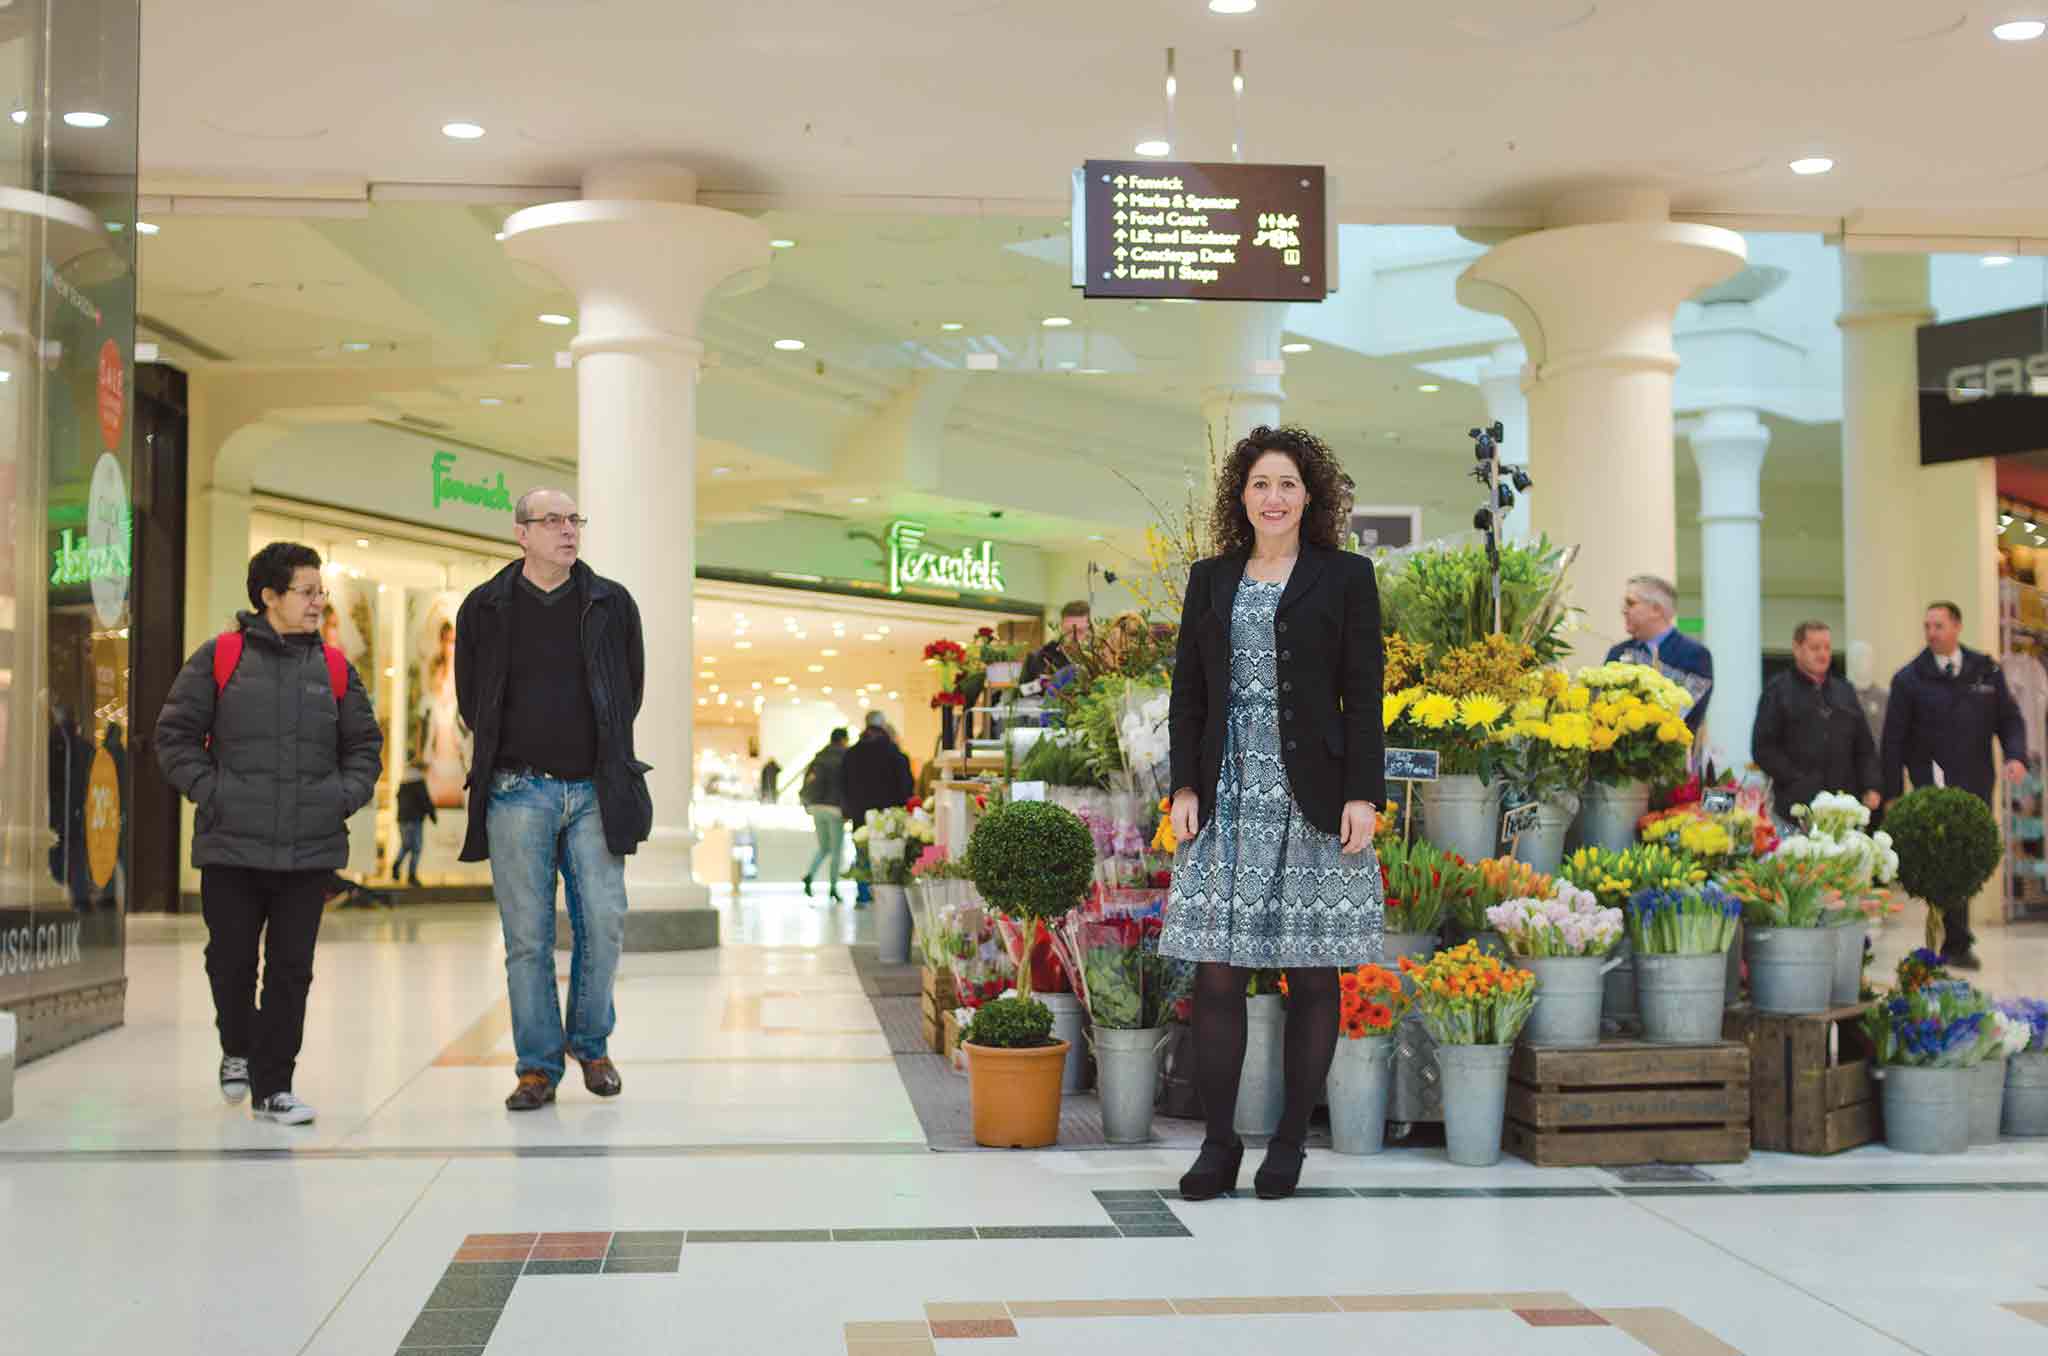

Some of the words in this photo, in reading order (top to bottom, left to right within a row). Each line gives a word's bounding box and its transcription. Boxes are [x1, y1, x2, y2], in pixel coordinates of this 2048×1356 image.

[1129, 175, 1184, 190] Fenwick
[1129, 193, 1171, 208] Marks
[1171, 194, 1185, 208] &
[1185, 194, 1240, 212] Spencer
[1130, 211, 1165, 226] Food
[1165, 211, 1209, 227] Court
[1130, 228, 1153, 243] Lift
[1153, 229, 1180, 244] and
[1180, 230, 1241, 246] Escalator
[1130, 246, 1199, 266] Concierge
[1200, 248, 1236, 263] Desk
[1130, 265, 1165, 280] Level
[1168, 265, 1175, 279] 1
[1178, 266, 1219, 284] Shops
[432, 450, 513, 513] Fenwick
[887, 520, 1005, 594] Fenwick
